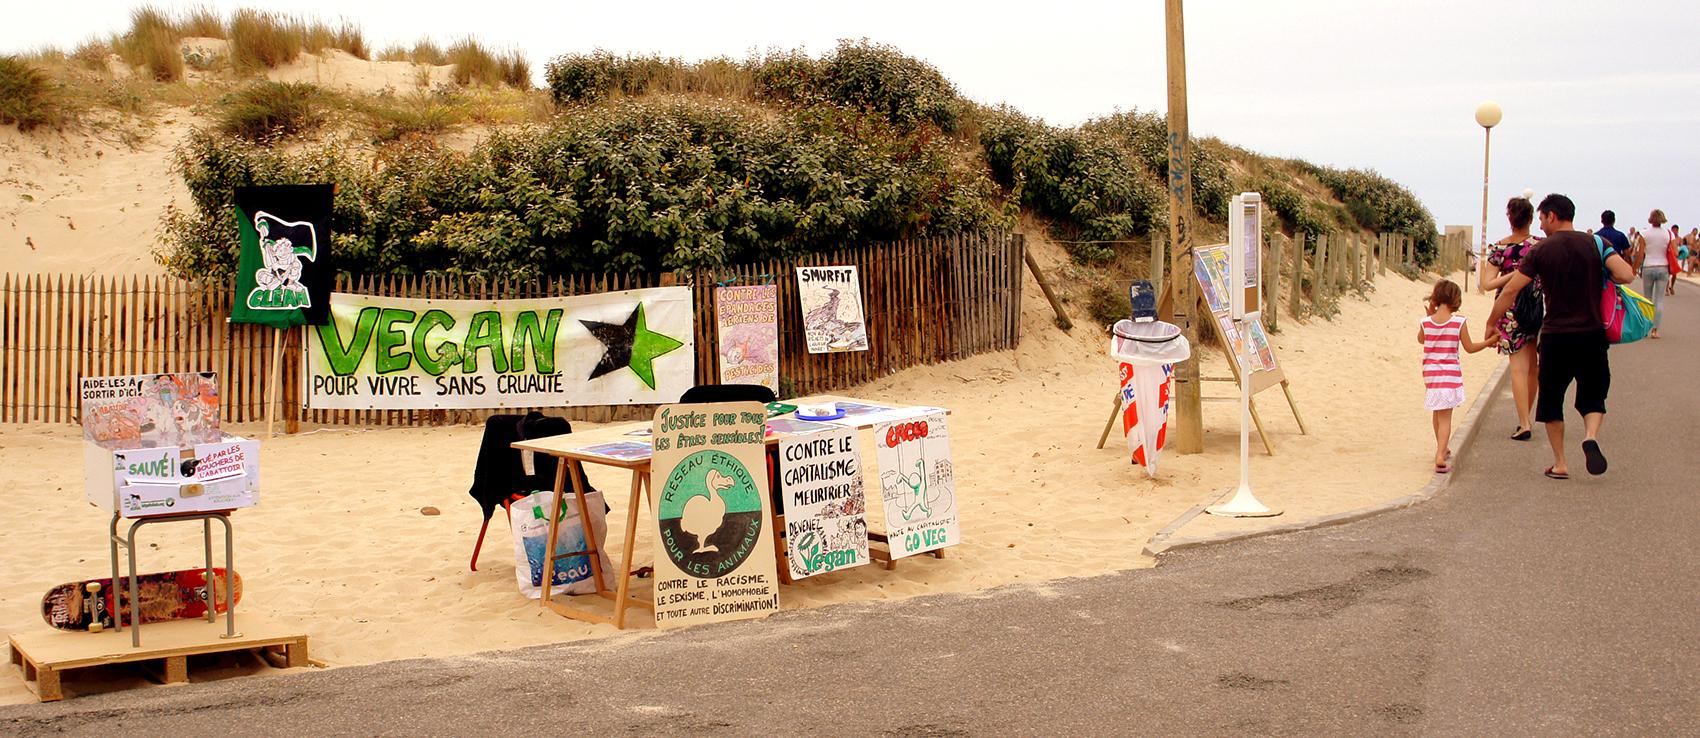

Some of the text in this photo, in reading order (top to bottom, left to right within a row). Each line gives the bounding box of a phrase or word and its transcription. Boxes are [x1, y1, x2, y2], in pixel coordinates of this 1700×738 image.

[314, 306, 564, 376] VEGAN
[314, 375, 358, 396] POUR
[435, 375, 486, 396] SANS
[497, 370, 564, 394] CRUAUTÉ
[713, 413, 737, 426] POUR
[740, 412, 764, 424] TOUS
[655, 437, 670, 451] LES
[677, 433, 706, 448] ÊTRES
[786, 436, 852, 461] CONTRE LE
[213, 450, 226, 459] PAR
[227, 445, 241, 455] LES
[235, 453, 245, 462] DE
[664, 453, 754, 503] RÉSEAU ÉTHIQUE
[789, 519, 823, 537] DEVENEZ
[664, 529, 684, 562] POUR
[687, 561, 710, 575] LES
[717, 519, 760, 573] ANIMAUX
[905, 527, 946, 552] GO VEG
[799, 542, 857, 572] Vegan
[658, 579, 688, 592] CONTRE
[696, 579, 708, 589] LE
[657, 596, 667, 606] LE
[656, 611, 665, 622] ET
[667, 608, 688, 619] TOUTE
[690, 606, 711, 617] AUTRE
